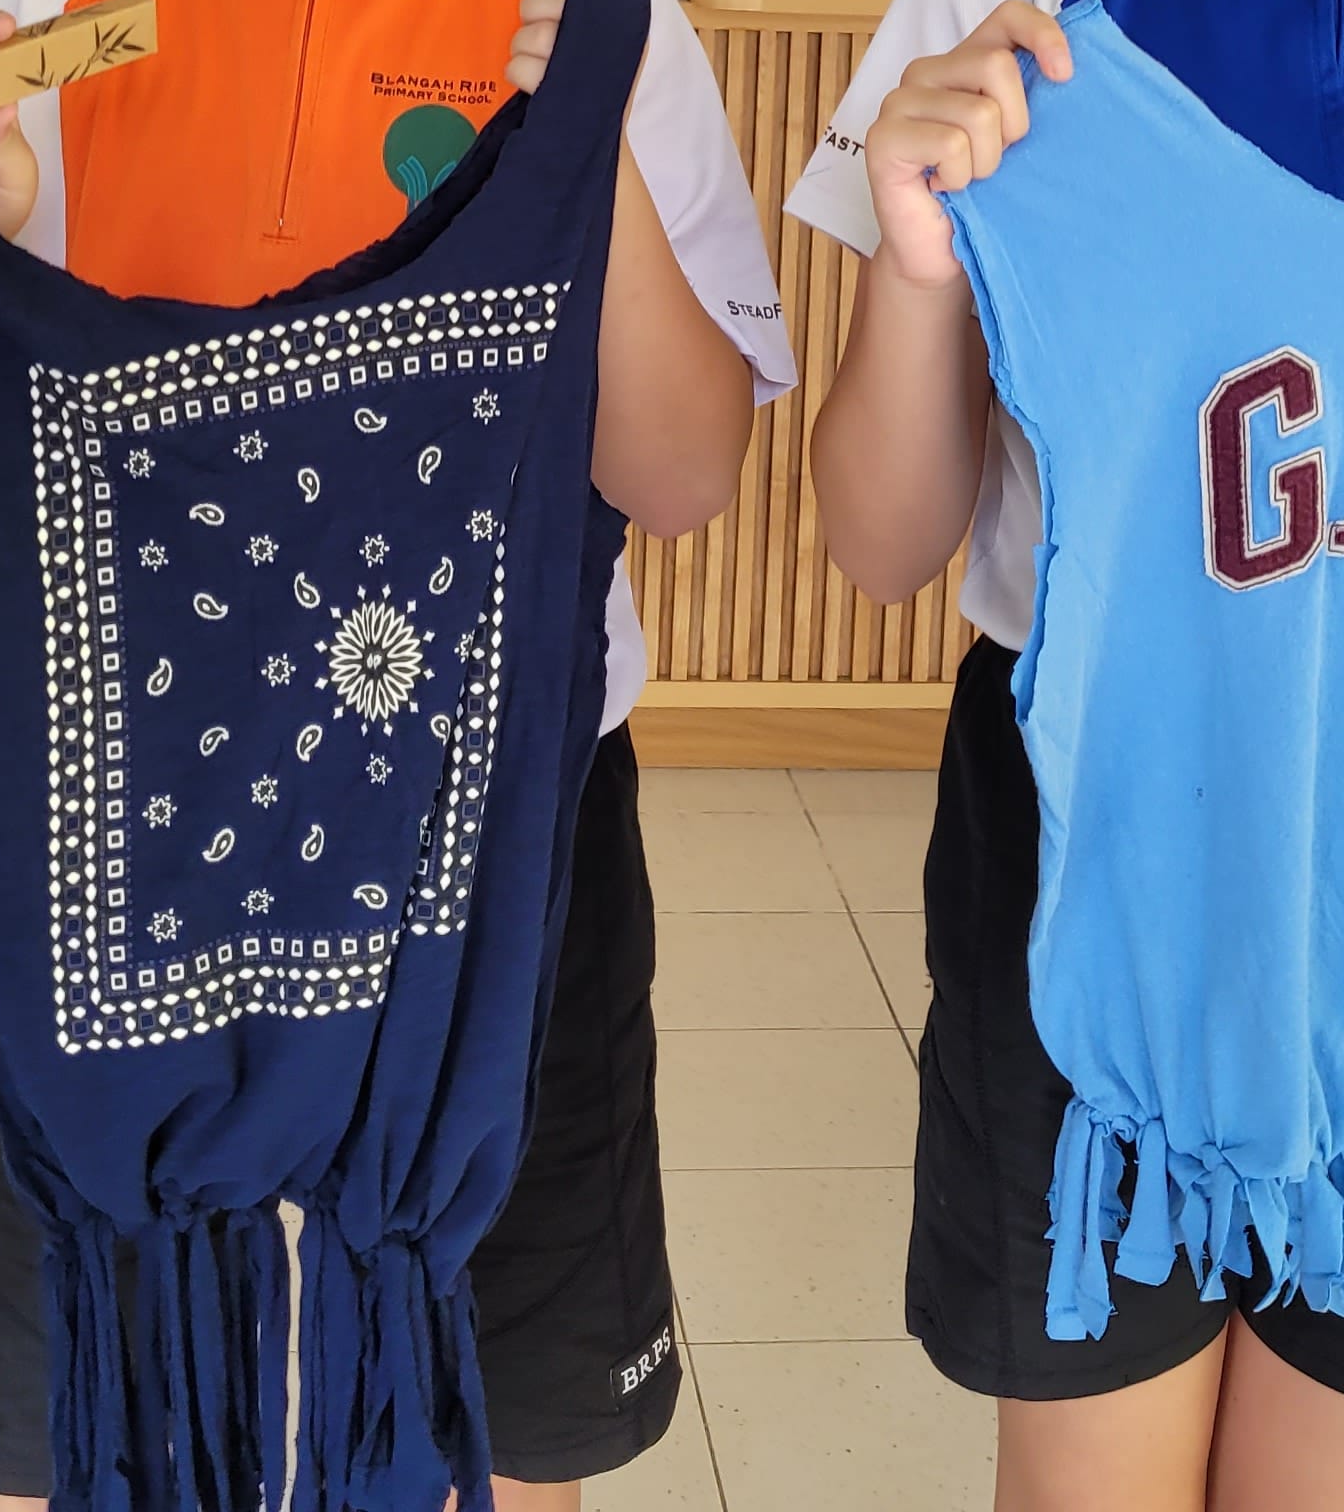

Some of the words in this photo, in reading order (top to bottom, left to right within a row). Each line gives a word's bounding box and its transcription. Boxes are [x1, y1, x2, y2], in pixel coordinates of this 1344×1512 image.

[370, 72, 454, 91] BLANGAH
[459, 79, 497, 93] RISE
[373, 86, 433, 101] PRIMARY
[438, 90, 492, 104] SCHOOL
[621, 1326, 671, 1394] BRPS
